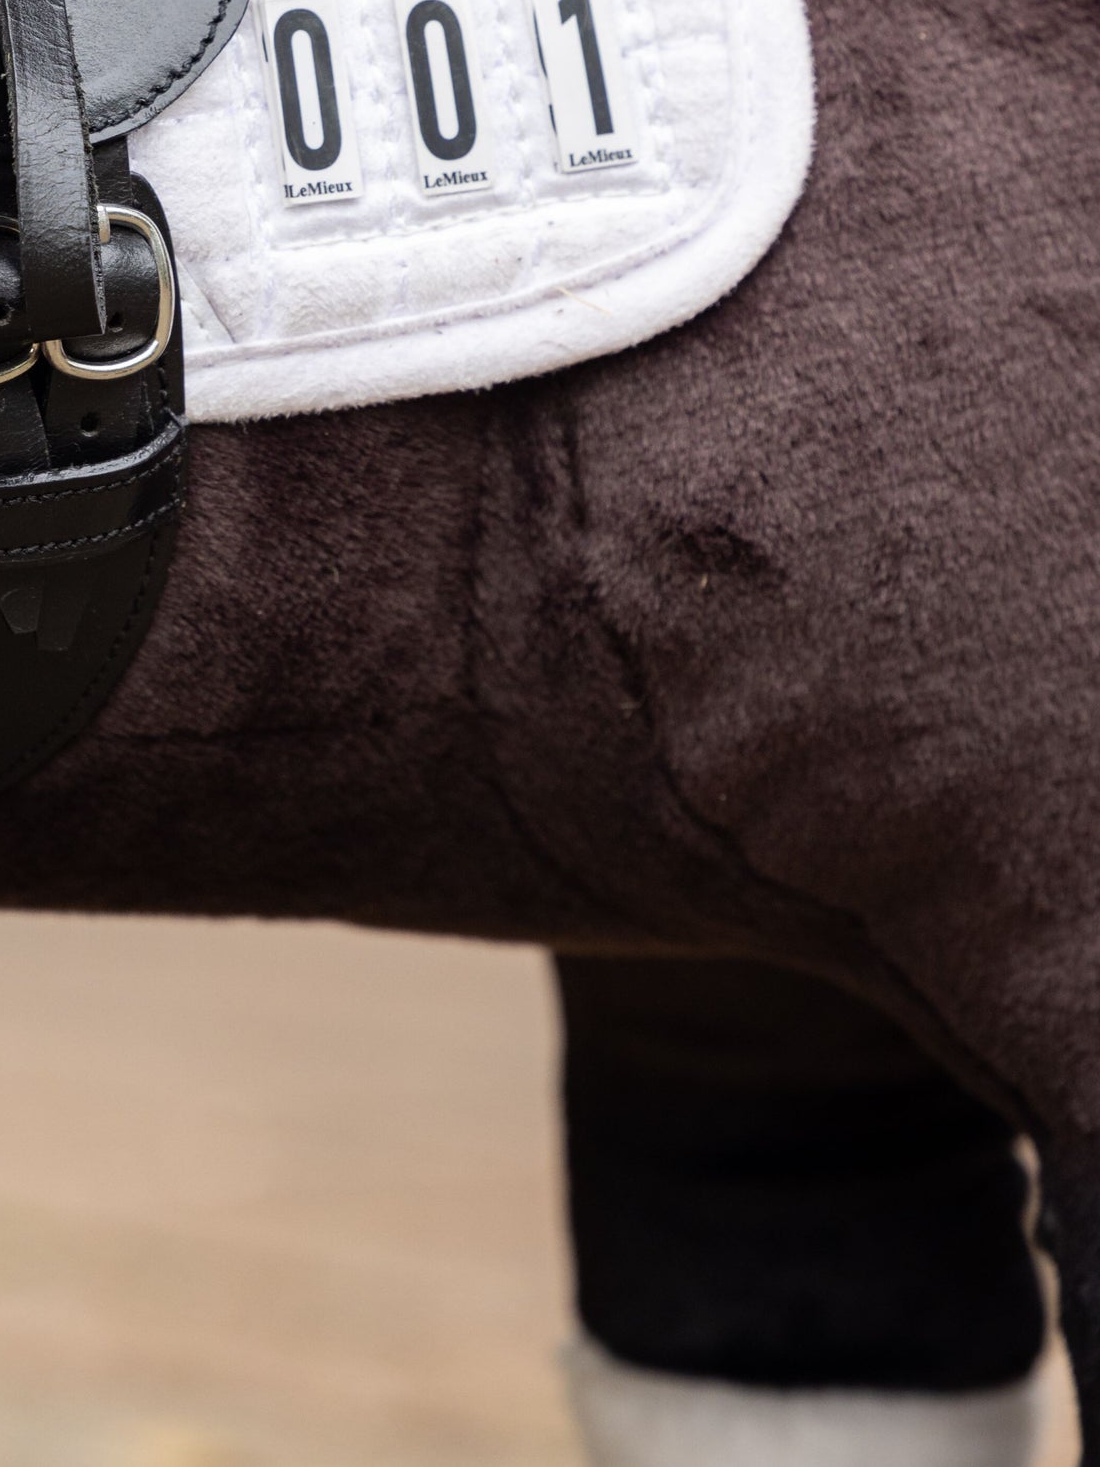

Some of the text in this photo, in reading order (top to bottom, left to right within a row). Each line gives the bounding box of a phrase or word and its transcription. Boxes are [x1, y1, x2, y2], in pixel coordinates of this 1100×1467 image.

[568, 147, 634, 168] LeMieux
[288, 179, 354, 199] LeMieux
[423, 169, 489, 190] LeMieux
